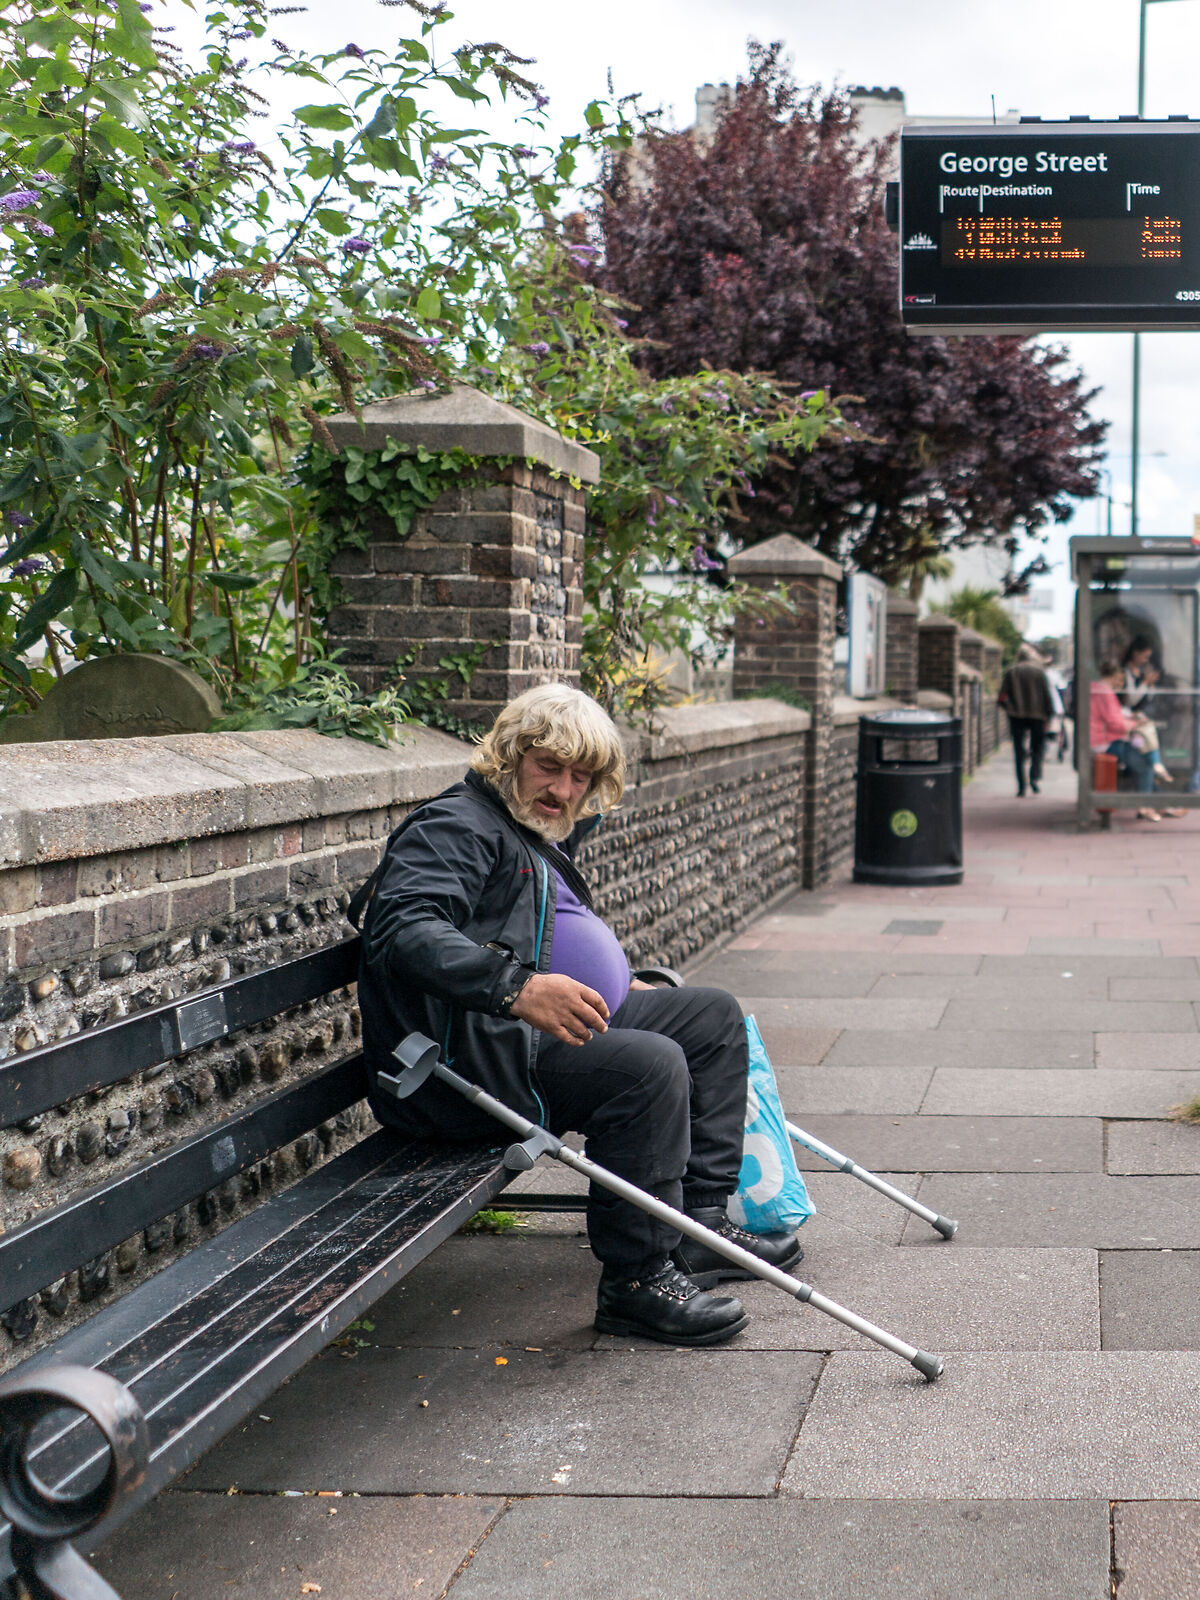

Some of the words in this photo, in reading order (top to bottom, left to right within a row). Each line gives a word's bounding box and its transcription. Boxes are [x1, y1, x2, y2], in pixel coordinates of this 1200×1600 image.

[939, 152, 1028, 178] George
[1035, 151, 1108, 173] Street
[943, 185, 979, 197] Route
[983, 184, 1053, 196] Destination
[1131, 183, 1160, 195] Time
